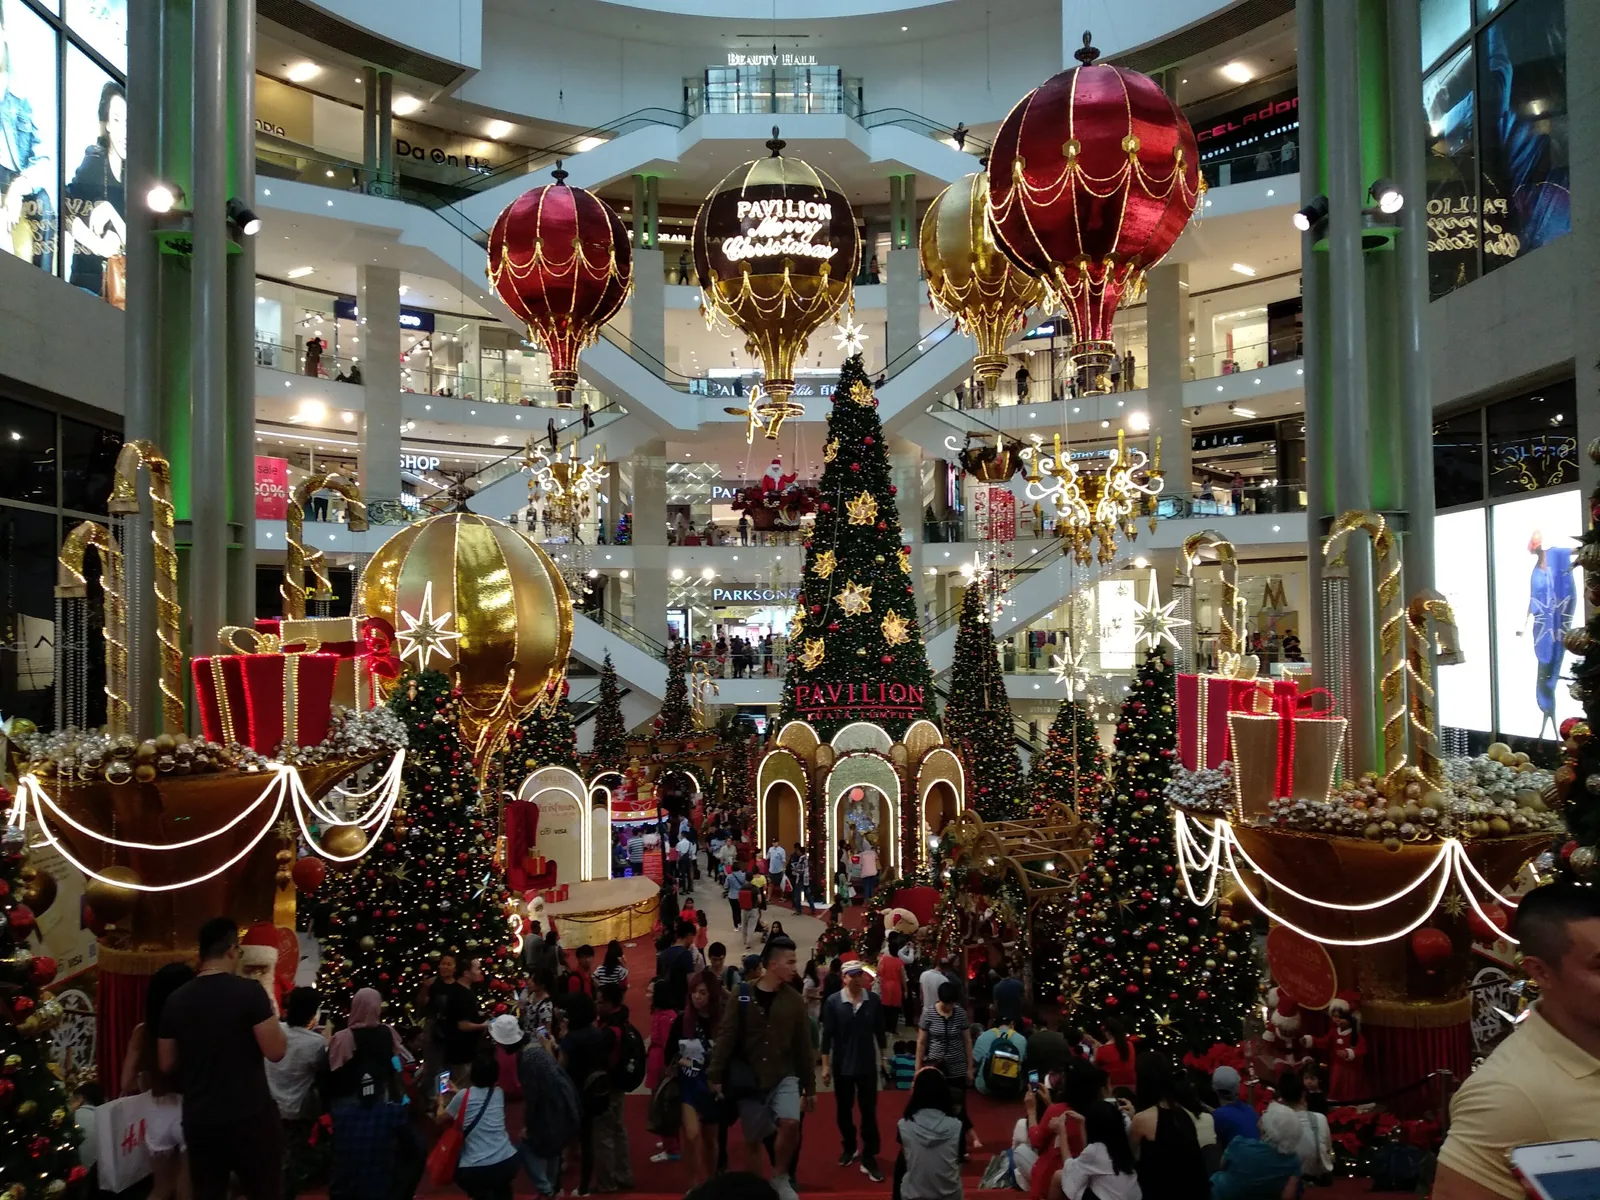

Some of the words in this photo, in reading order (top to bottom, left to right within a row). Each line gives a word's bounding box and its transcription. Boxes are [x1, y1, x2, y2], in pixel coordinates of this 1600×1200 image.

[782, 53, 818, 66] HALL
[1264, 121, 1299, 139] CUISIN
[396, 138, 425, 161] Da
[737, 199, 832, 220] PAVILION
[747, 216, 823, 243] Merry
[722, 235, 839, 261] Christmas
[713, 588, 788, 601] PARKSON
[795, 682, 924, 706] PAVILION
